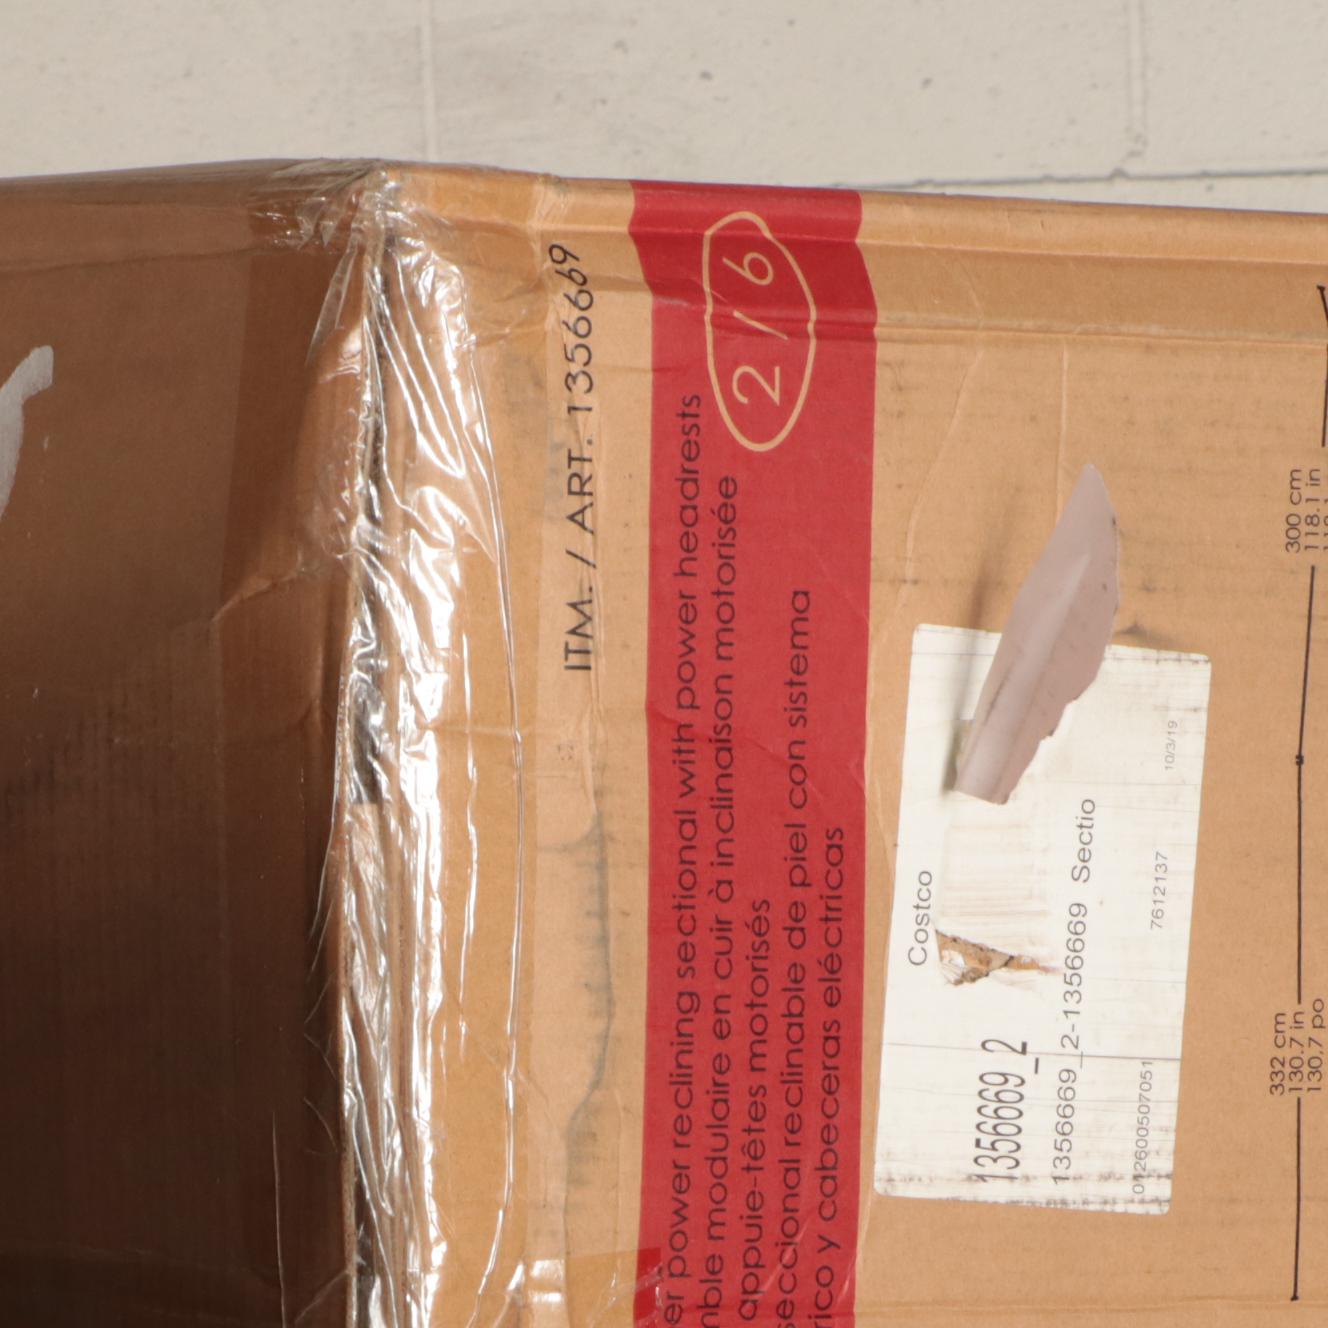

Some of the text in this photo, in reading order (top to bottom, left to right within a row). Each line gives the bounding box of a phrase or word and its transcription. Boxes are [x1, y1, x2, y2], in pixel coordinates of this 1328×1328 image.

[723, 252, 780, 406] 2 6
[548, 245, 594, 671] ITM. ART. 1356669
[674, 394, 701, 577] headrests
[1284, 469, 1302, 554] 300 cm
[1304, 468, 1321, 552] 118.1 in
[711, 477, 736, 661] motorisée
[674, 590, 701, 711] power
[785, 590, 811, 729] sistema
[672, 723, 698, 797] with
[706, 673, 736, 867] inclinaison
[785, 740, 808, 809] con
[1164, 720, 1178, 771] 10/3/19
[672, 809, 698, 980] sectional
[708, 879, 734, 899] à
[783, 823, 812, 888] piel
[1150, 852, 1168, 930] 7612137
[708, 918, 734, 980] cuir
[783, 901, 807, 950] de
[815, 828, 843, 1007] eléctricas
[907, 870, 933, 966] Costco
[710, 994, 733, 1041] en
[745, 899, 770, 1073] motorisés
[1052, 798, 1096, 1185] 1356669_2-1356669 Sectio
[1309, 998, 1326, 1030] po
[666, 990, 700, 1149] reclining
[779, 962, 806, 1147] reclinable
[974, 1038, 1040, 1184] 1356669_2
[1269, 1013, 1286, 1096] 332 cm
[1289, 1011, 1305, 1094] 130.7 in
[704, 1052, 731, 1242] modulaire
[813, 1021, 841, 1221] cabeceras
[663, 1160, 691, 1278] power
[738, 1085, 768, 1319] appuie-têtes
[815, 1235, 841, 1253] y
